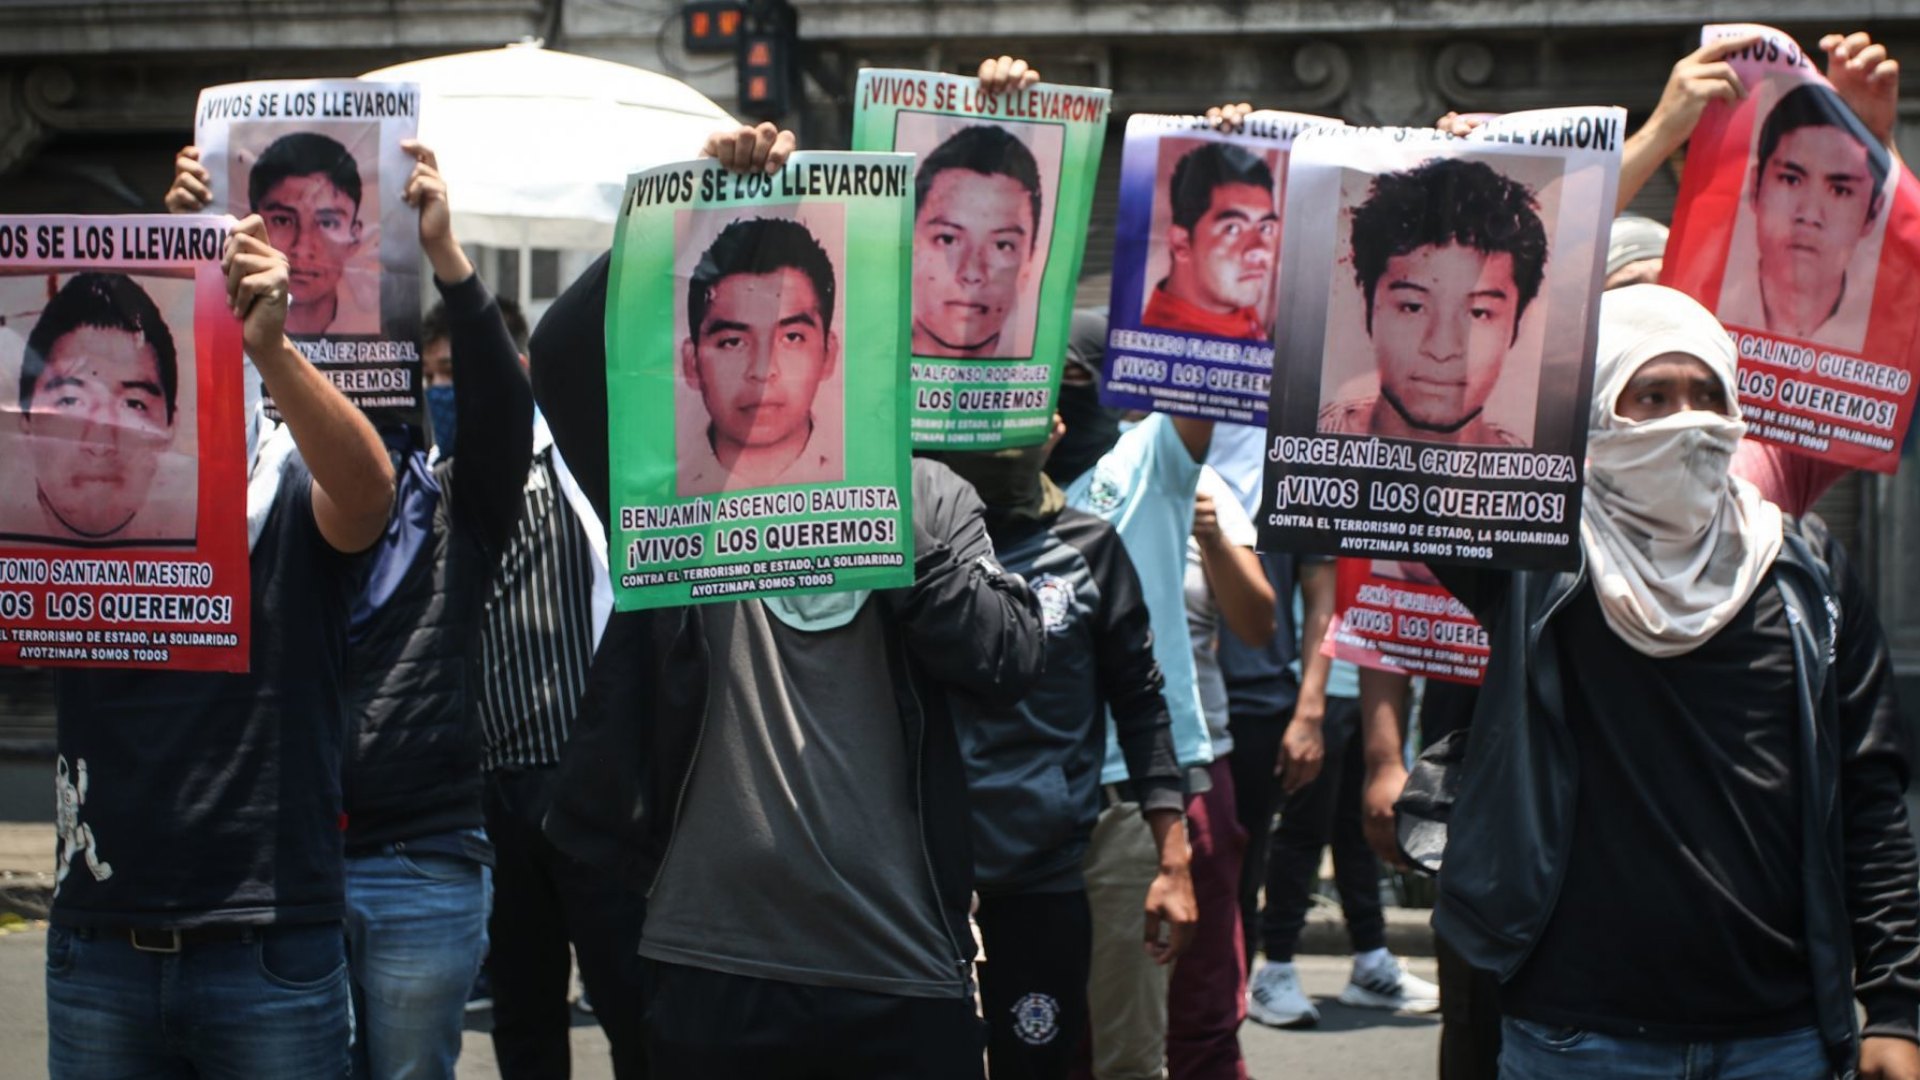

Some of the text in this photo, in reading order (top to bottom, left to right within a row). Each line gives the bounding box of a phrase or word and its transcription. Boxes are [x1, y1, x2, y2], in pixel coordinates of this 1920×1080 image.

[200, 92, 414, 127] ¡VIVOS SE LOS LLEVARON!
[863, 76, 1104, 123] ¡VIVOS SE LOS LLEVARON!
[626, 163, 907, 216] ¡VIVOS SE LOS LLEVARON!
[37, 225, 65, 259] SE
[73, 226, 115, 260] LOS
[358, 341, 419, 363] PARRAL
[1741, 337, 1910, 393] GALINDO GUERRERO
[325, 370, 411, 392] EREMOS!
[924, 366, 982, 382] ALFONSO
[985, 363, 1048, 381] RODRÍGUEZ
[1113, 355, 1167, 383] ¡VIVOS
[1172, 363, 1206, 387] LOS
[919, 389, 1049, 412] LOS QUEREMOS!
[1738, 371, 1896, 427] LOS QUEREMOS!
[1763, 409, 1776, 423] DE
[1818, 423, 1831, 436] LA
[1833, 425, 1894, 451] SOLIDARIDAD
[1763, 425, 1797, 444] SOMOS
[1798, 433, 1829, 452] TODOS
[1270, 436, 1577, 481] JORGE ANÍBAL CRUZ MENDOZA
[621, 488, 898, 530] BENJAMÍN ASCENCIO BAUTISTA
[1278, 476, 1566, 523] ¡VIVOS LOS QUEREMOS!
[629, 520, 896, 569] ¡VIVOS LOS QUEREMOS!
[1269, 513, 1570, 546] CONTRA EL TERRORISMO DE ESTADO, LA SOLIDARIDAD
[1340, 536, 1493, 559] AYOTZINAPA SOMOS TODOS
[52, 561, 130, 585] SANTANA
[136, 563, 211, 586] MAESTRO
[621, 553, 904, 588] CONTRA EL TERRORISMO DE ESTADO, LA SOLIDARIDAD
[691, 573, 834, 598] AYOTZINAPA SOMOS TODOS
[47, 594, 92, 618] LOS
[100, 596, 231, 623] QUEREMOS!
[1343, 607, 1393, 635] ¡VIVOS
[1399, 616, 1429, 641] LOS
[12, 630, 83, 643] TERRORISMO
[87, 631, 101, 643] DE
[104, 632, 150, 645] ESTADO,
[152, 633, 167, 644] LA
[169, 634, 238, 646] SOLIDARIDAD
[20, 647, 169, 661] AYOTZINAPA SOMOS TODOS
